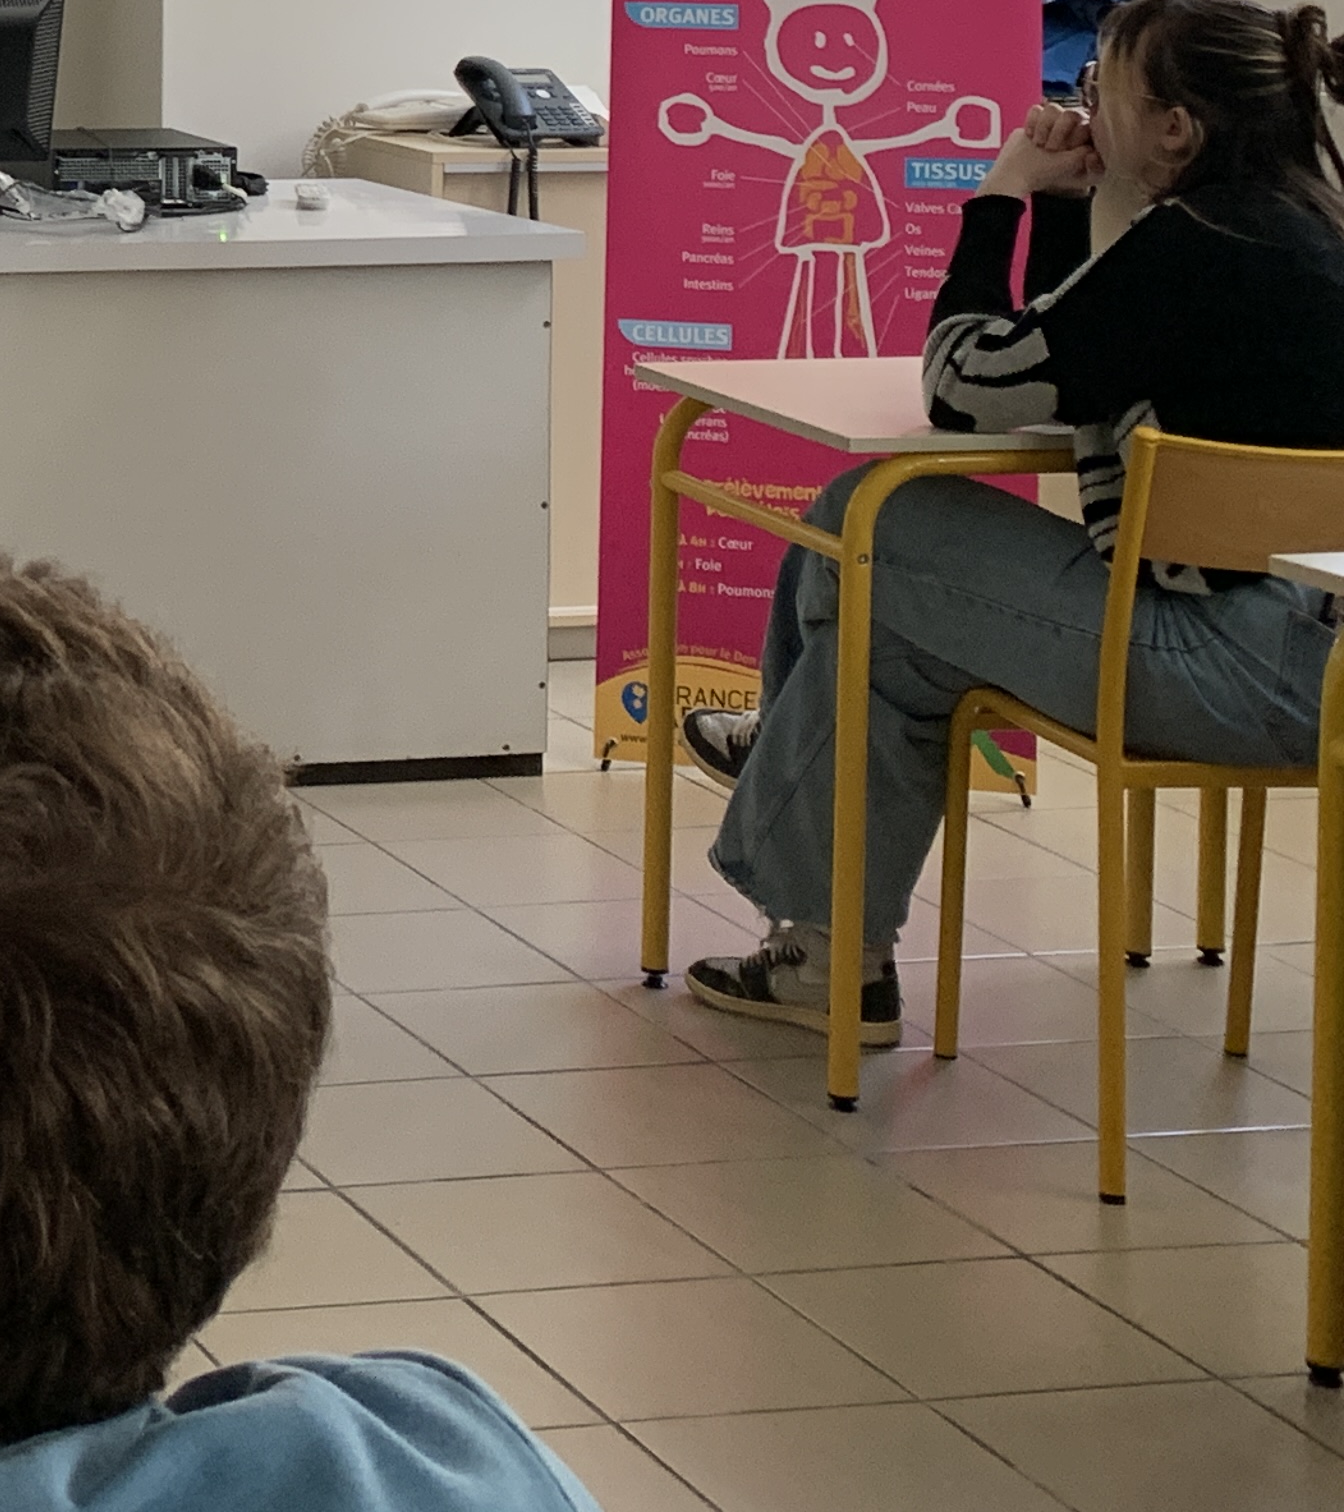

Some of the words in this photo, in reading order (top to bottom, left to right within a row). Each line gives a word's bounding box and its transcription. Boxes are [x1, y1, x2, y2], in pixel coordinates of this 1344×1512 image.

[640, 7, 735, 25] ORGANES
[907, 101, 937, 113] Peau
[711, 169, 736, 181] Foie
[912, 162, 987, 181] TISSUS
[905, 202, 945, 214] Valves
[702, 223, 735, 236] Reins
[905, 223, 922, 235] Os
[904, 245, 945, 257] Veines
[681, 251, 734, 265] Pancréas
[683, 278, 734, 291] Intestins
[632, 324, 729, 345] CELLULES
[718, 537, 754, 551] Cœur
[695, 558, 722, 572] Foie
